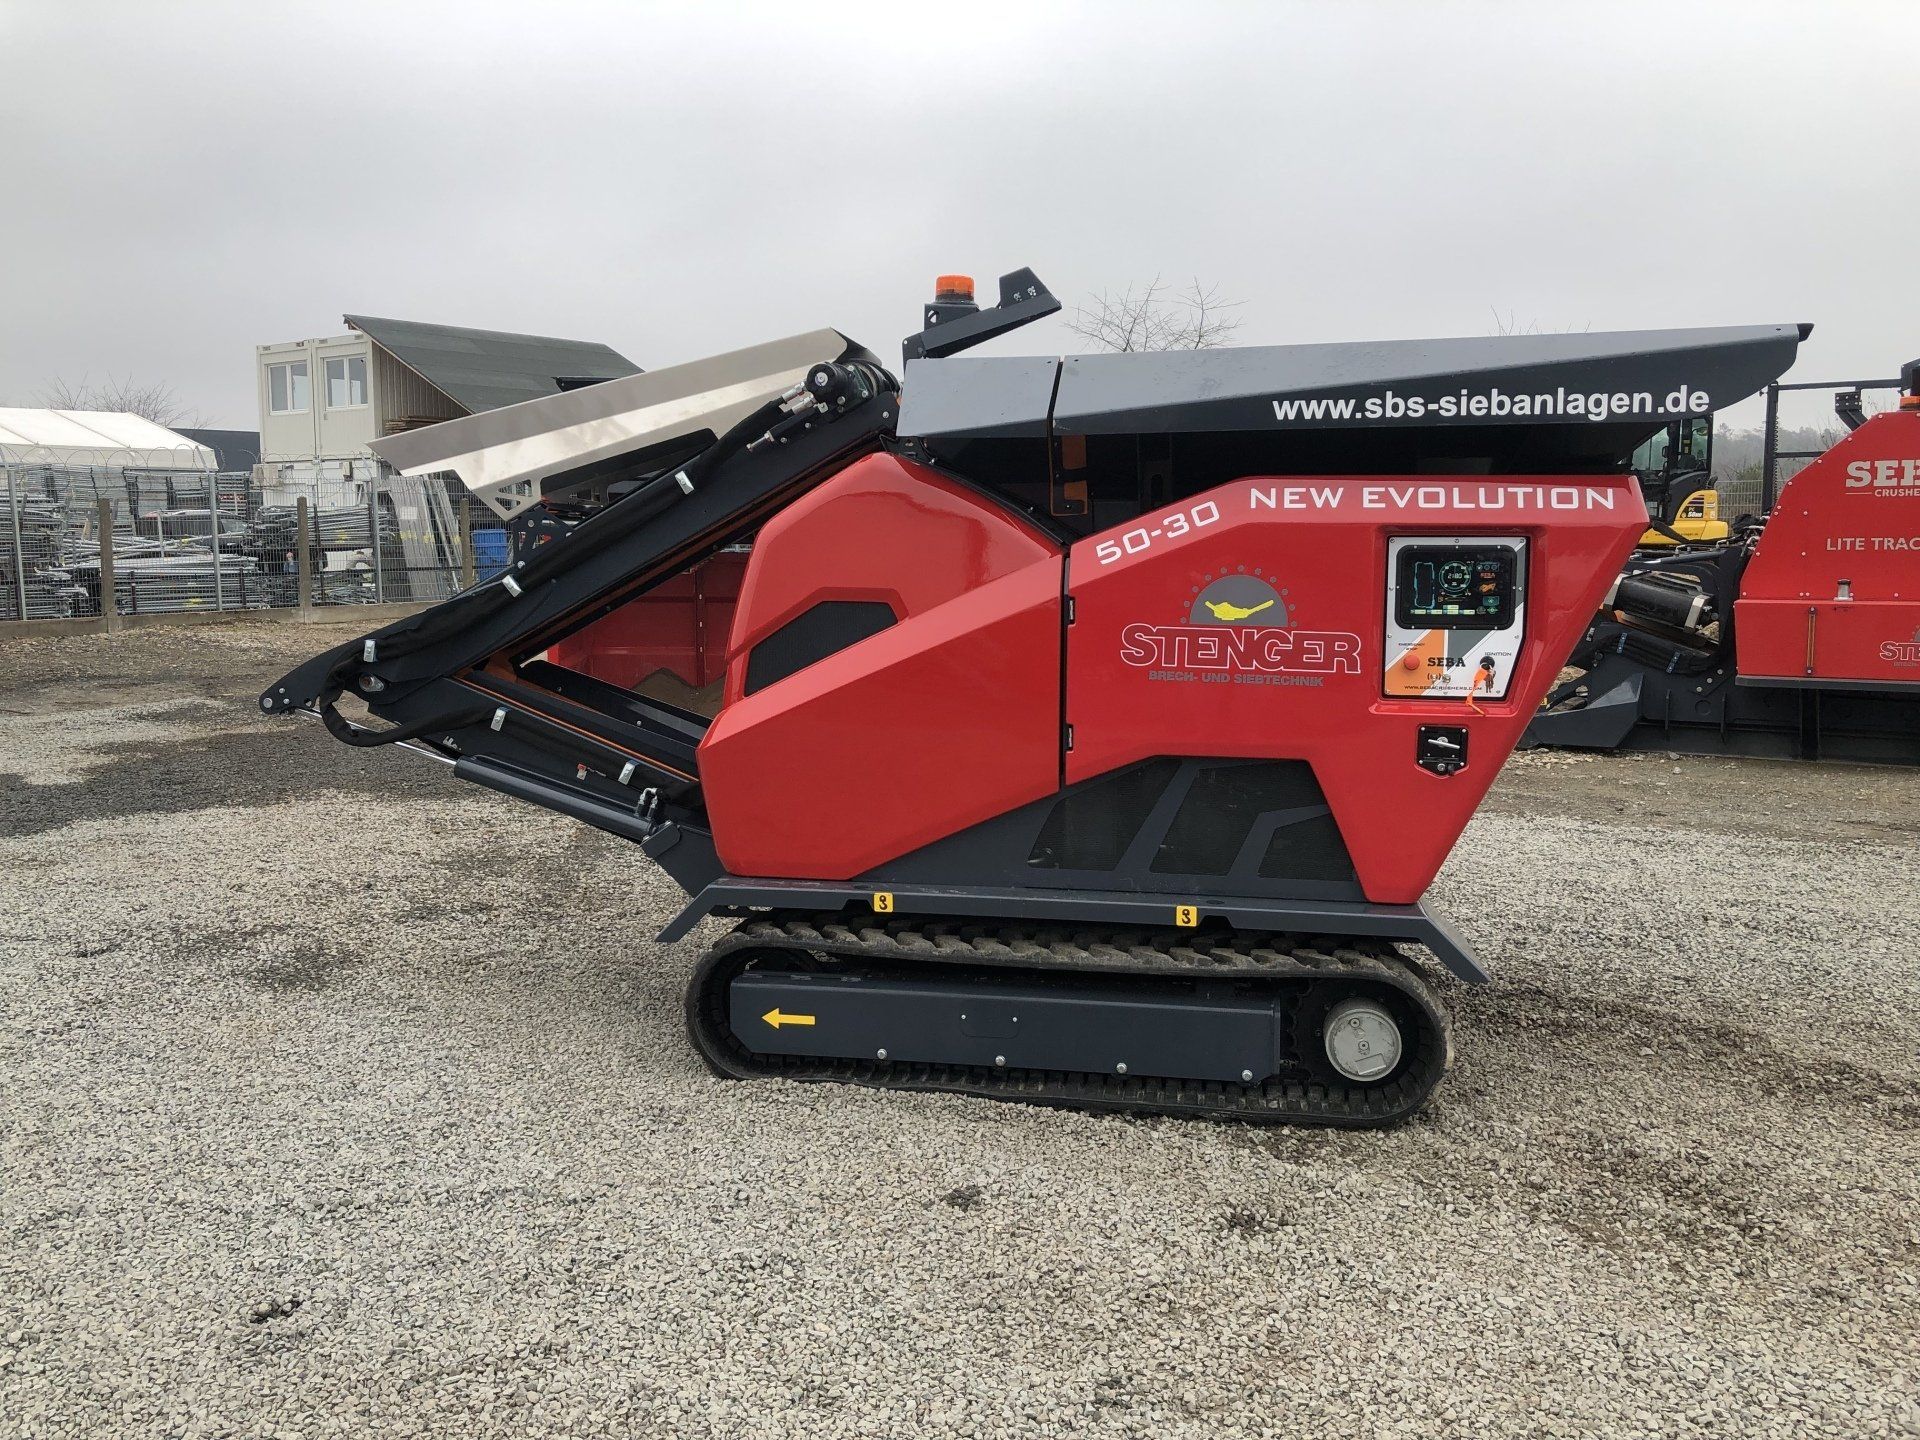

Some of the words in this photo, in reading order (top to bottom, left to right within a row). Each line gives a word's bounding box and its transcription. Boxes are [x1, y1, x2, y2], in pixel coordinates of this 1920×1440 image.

[1272, 384, 1710, 421] www.sbs-siebanlagen.de
[1249, 486, 1345, 510] NEW
[1362, 486, 1615, 511] EVOLUTION
[1874, 488, 1920, 497] CRUSHE
[1095, 500, 1220, 565] 50-30
[1826, 537, 1865, 551] LITE
[1870, 537, 1920, 551] TRAC
[1120, 623, 1362, 674] STENGER
[1879, 640, 1920, 661] STE
[1427, 656, 1466, 668] SEBA
[1148, 670, 1198, 683] BRECH-
[1201, 672, 1230, 684] UND
[1233, 674, 1324, 687] SIEBTECHNIK
